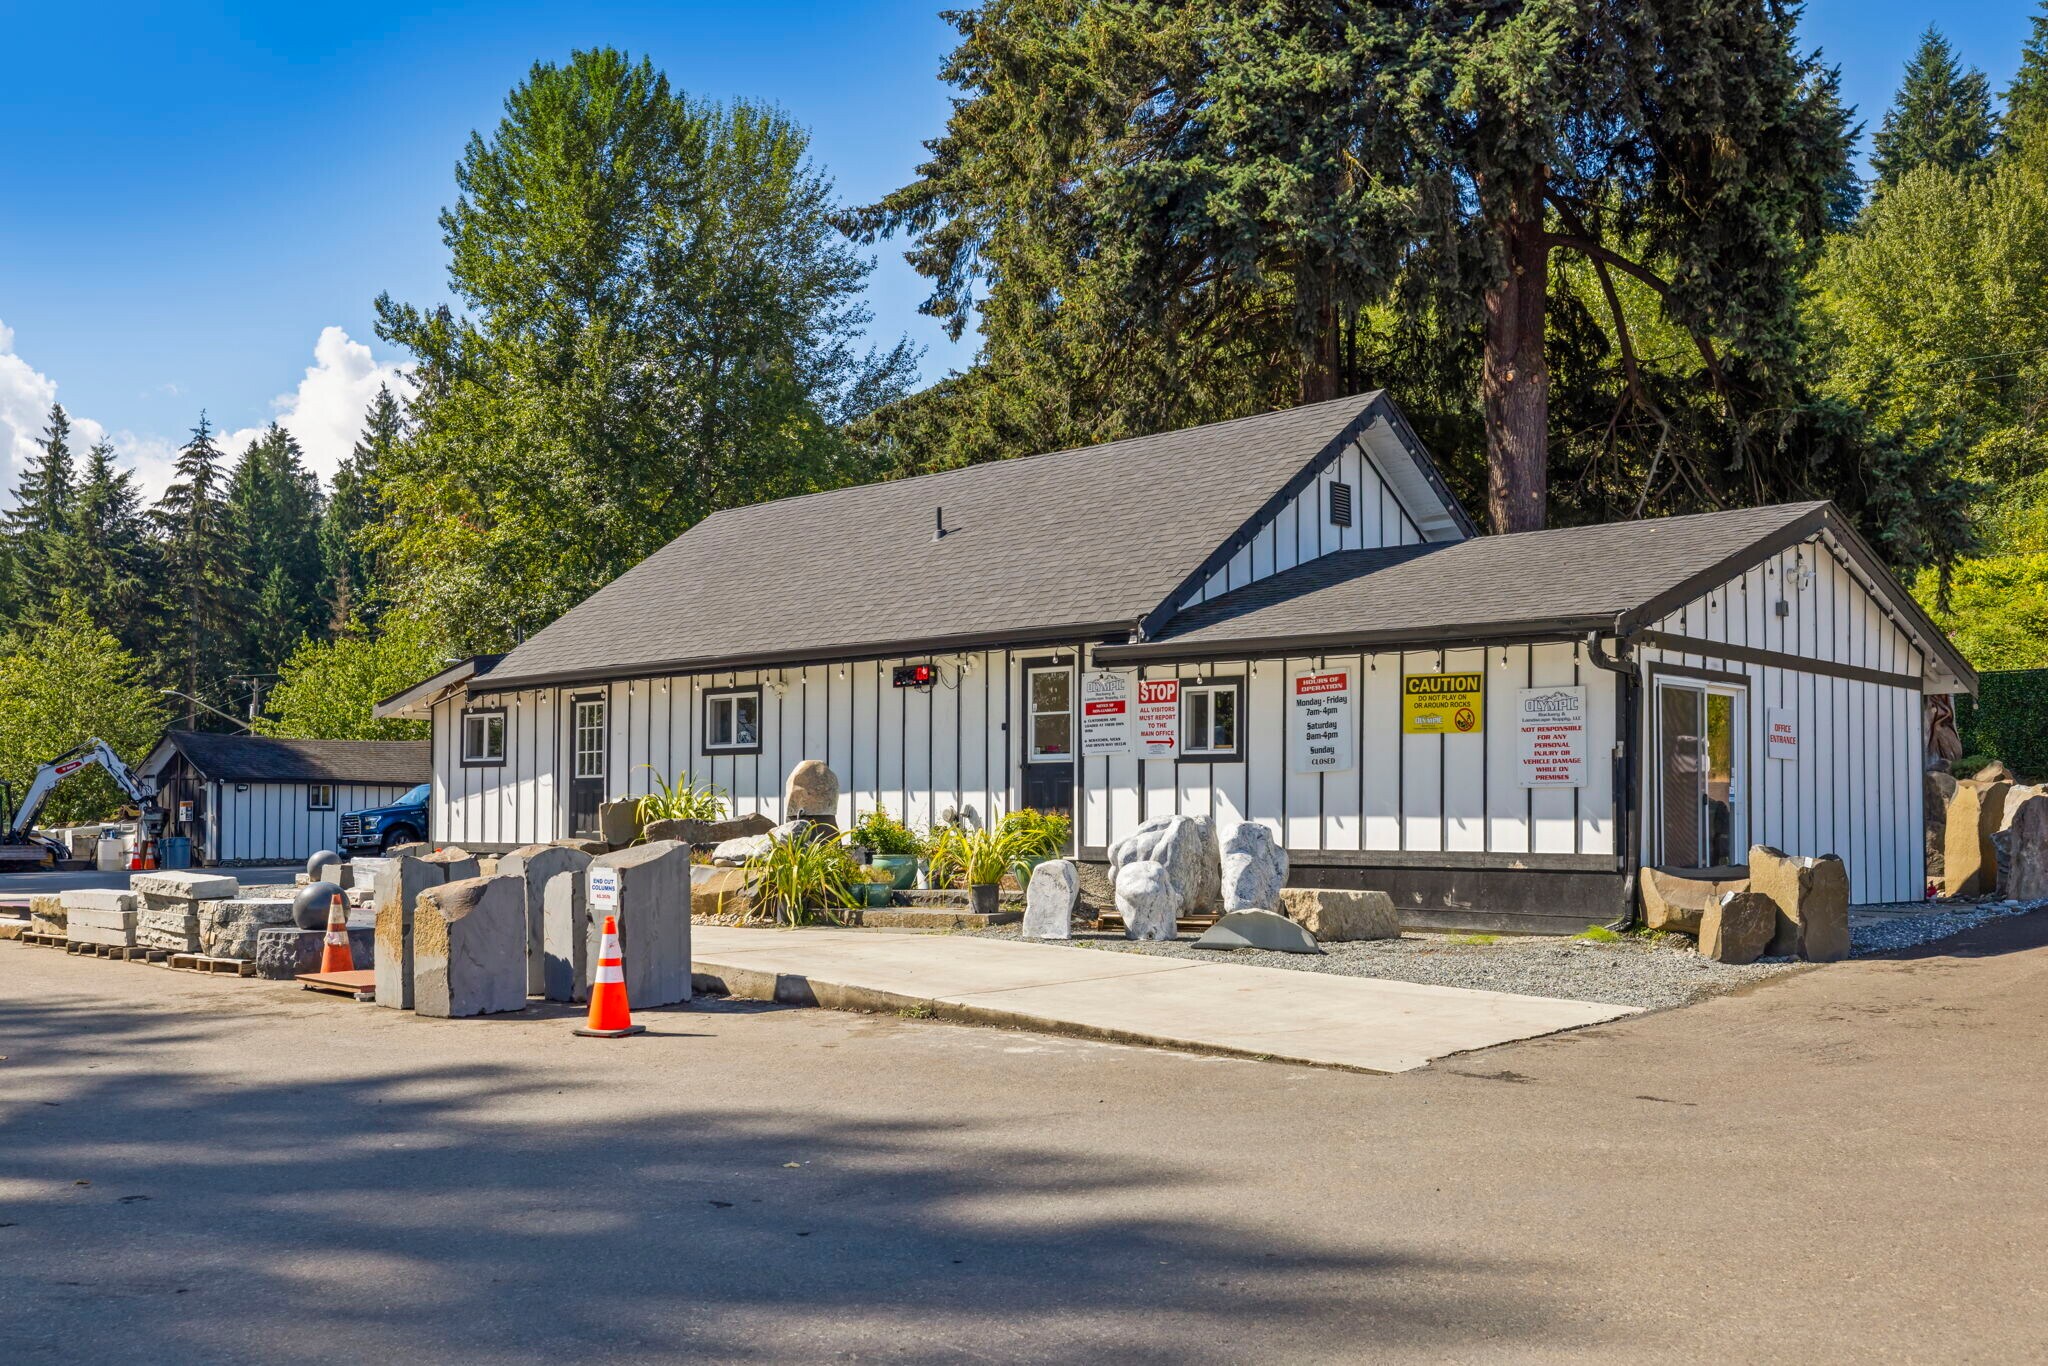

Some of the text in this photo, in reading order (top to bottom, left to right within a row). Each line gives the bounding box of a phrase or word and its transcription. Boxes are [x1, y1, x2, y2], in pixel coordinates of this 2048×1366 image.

[1087, 679, 1125, 692] OLYMPIC
[1302, 683, 1342, 692] OPERATION
[1408, 676, 1478, 692] CAUTION
[1140, 684, 1176, 701] STOP
[1296, 698, 1321, 706] Monday
[1326, 696, 1347, 704] Friday
[1525, 696, 1578, 712] OLYMPIC
[1307, 721, 1337, 730] Saturday
[1775, 724, 1791, 733] OFFICE
[1770, 735, 1796, 744] ENTRANCE
[1310, 746, 1335, 754] Sunday
